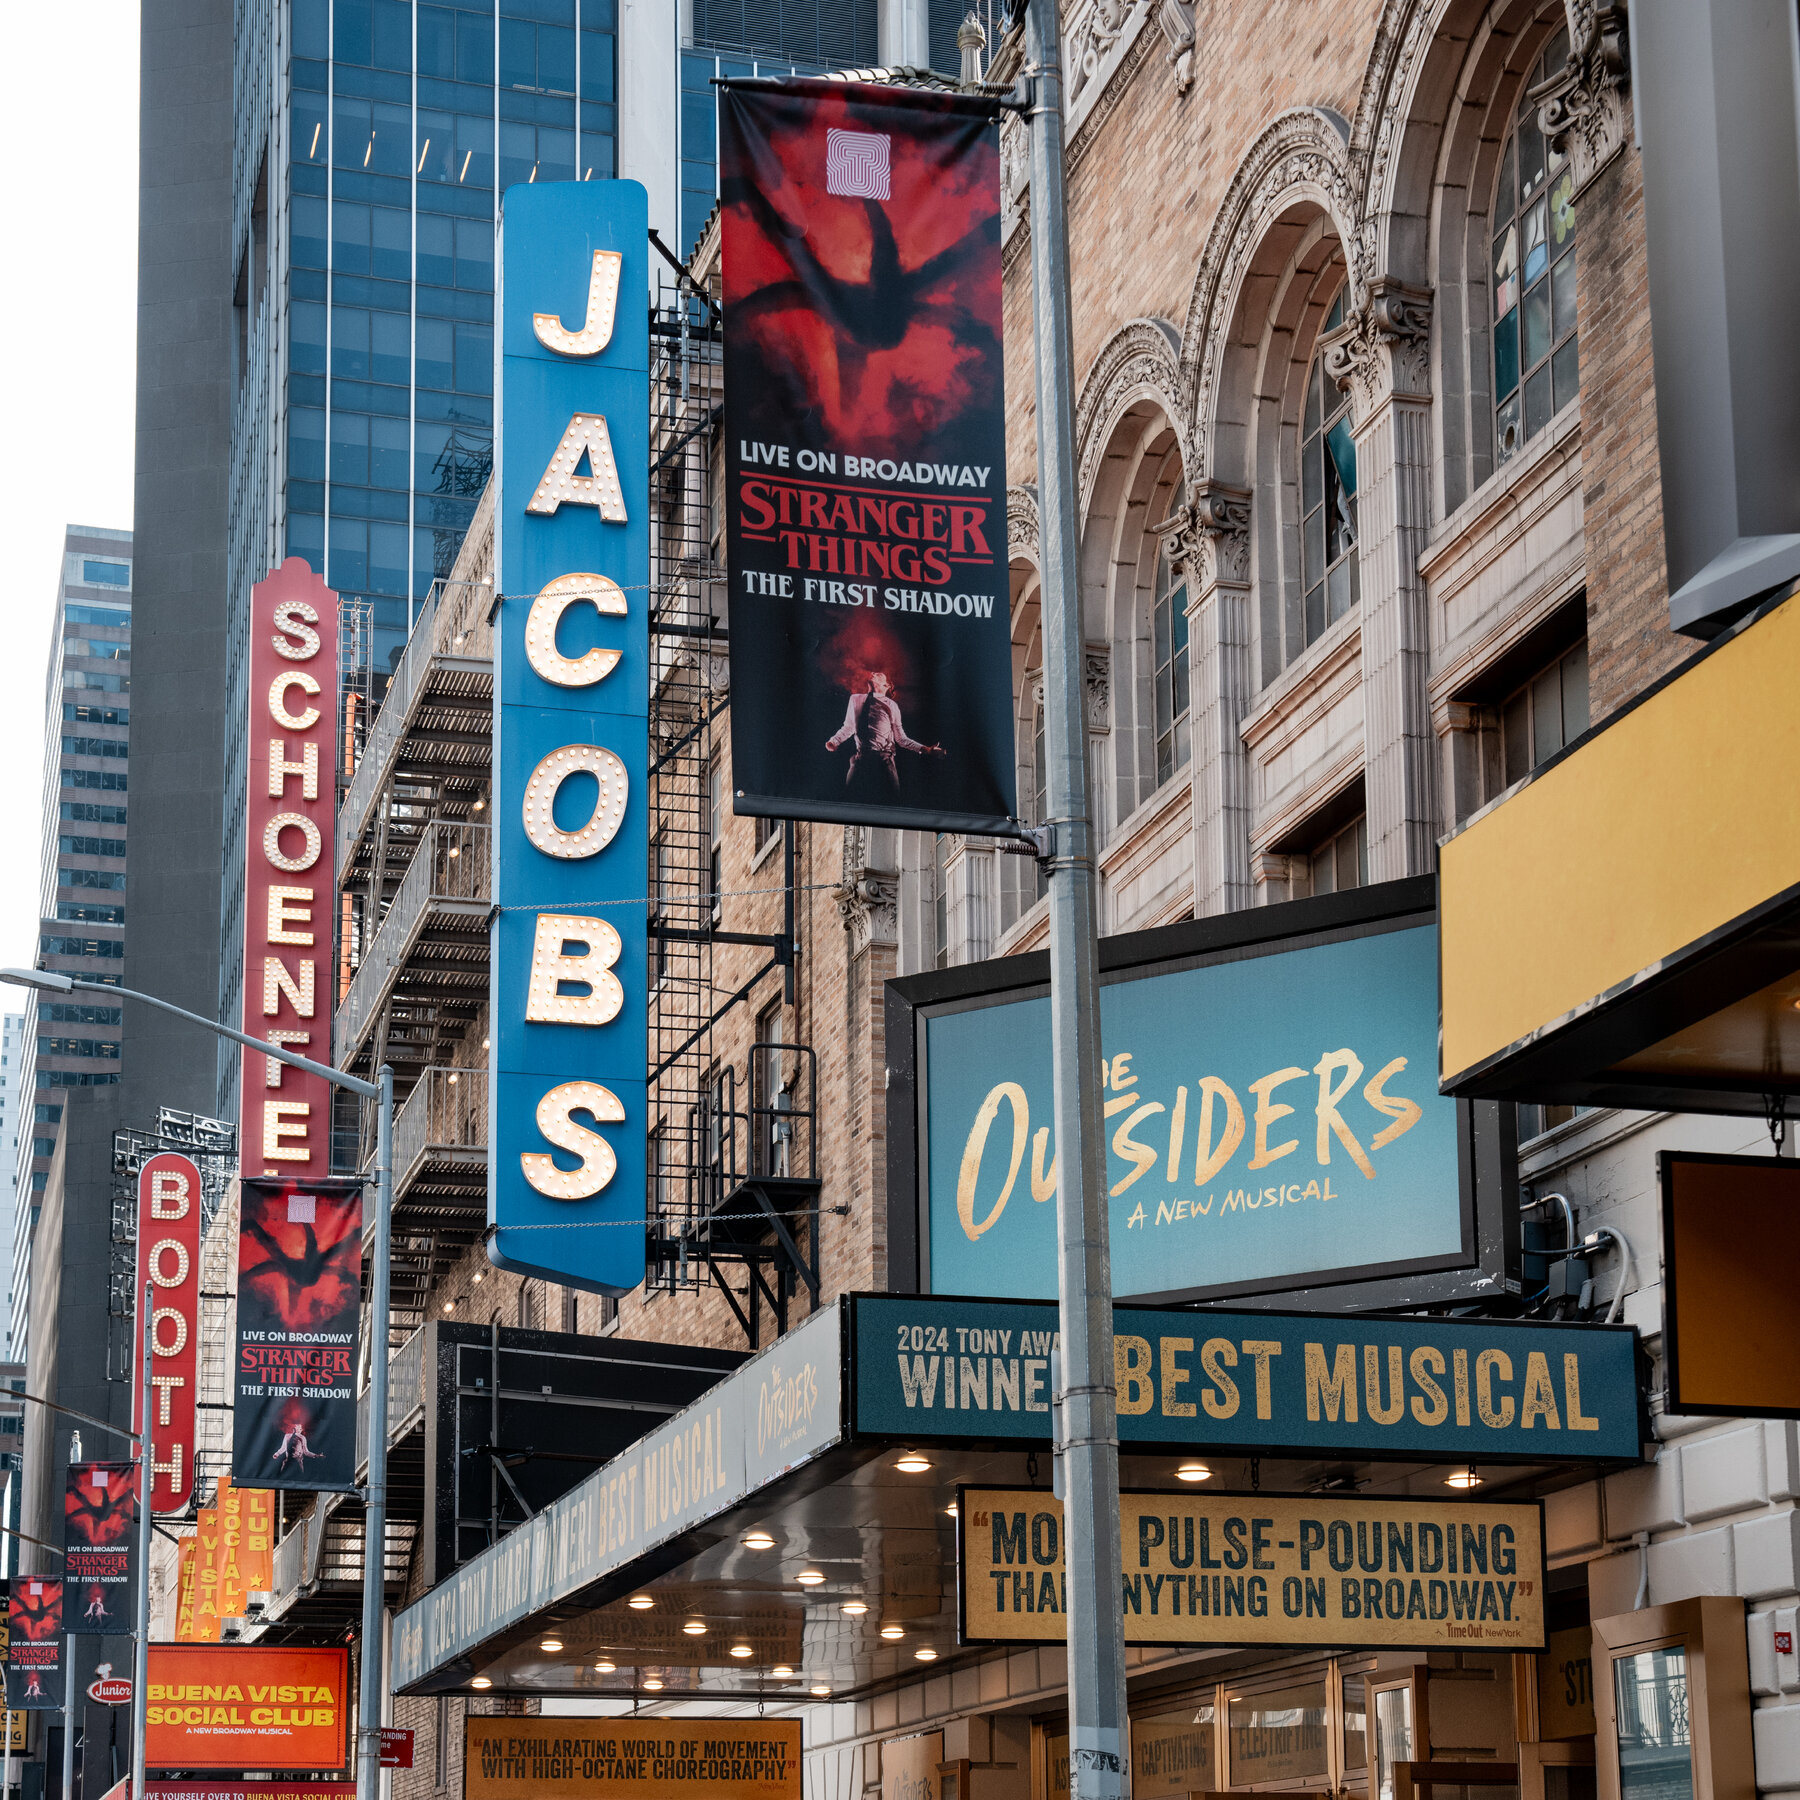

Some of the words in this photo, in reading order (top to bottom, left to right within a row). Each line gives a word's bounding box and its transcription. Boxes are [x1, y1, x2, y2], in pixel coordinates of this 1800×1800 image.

[740, 440, 790, 468] LIVE
[797, 449, 836, 475] ON
[844, 455, 991, 488] BROADWAY
[740, 481, 994, 555] STRANGER
[779, 530, 952, 585] THINGS
[742, 570, 794, 599] THE
[803, 578, 878, 608] FIRST
[884, 586, 995, 619] SHADOW
[521, 249, 629, 1201] JACOBS
[262, 601, 321, 1176] SCHOENFE
[1127, 1201, 1149, 1230] A
[1155, 1195, 1213, 1226] NEW
[1220, 1177, 1338, 1218] MUSICAL
[148, 1170, 190, 1493] BOOTH
[242, 1331, 265, 1341] LIVE
[268, 1332, 286, 1342] ON
[289, 1333, 353, 1344] BROADWAY
[898, 1325, 949, 1352] 2024
[956, 1328, 1012, 1355] TONY
[1019, 1331, 1060, 1356] AWA
[241, 1347, 352, 1372] STRANGER
[258, 1366, 333, 1386] THINGS
[898, 1354, 1048, 1412] WINNE
[1113, 1334, 1282, 1421] BEST
[1304, 1342, 1600, 1431] MUSICAL
[241, 1385, 264, 1396] THE
[268, 1386, 300, 1397] FIRST
[302, 1387, 352, 1399] SHADOW
[599, 1465, 637, 1558] BEST
[644, 1407, 726, 1532] MUSICAL
[66, 1555, 128, 1568] STRANGER
[223, 1498, 241, 1596] SOCIAL
[972, 1511, 1067, 1566] “MO
[1138, 1515, 1516, 1575] PULSE-POUNDING
[77, 1566, 118, 1576] THINGS
[989, 1571, 1067, 1613] THA
[1122, 1573, 1268, 1618] NYTHING
[1282, 1576, 1326, 1619] ON
[10, 1647, 58, 1659] STRANGER
[1446, 1622, 1467, 1638] Time
[1467, 1623, 1483, 1638] Out
[146, 1707, 244, 1726] SOCIAL
[250, 1708, 334, 1727] CLUB
[147, 1684, 244, 1702] BUENA
[247, 1686, 334, 1704] VISTA
[482, 1758, 527, 1779] WITH
[533, 1759, 647, 1780] HIGH-OCTANE
[508, 1739, 617, 1758] EXHILARATING
[622, 1740, 675, 1758] WORLD
[680, 1741, 698, 1758] OF
[704, 1741, 788, 1759] MOVEMENT
